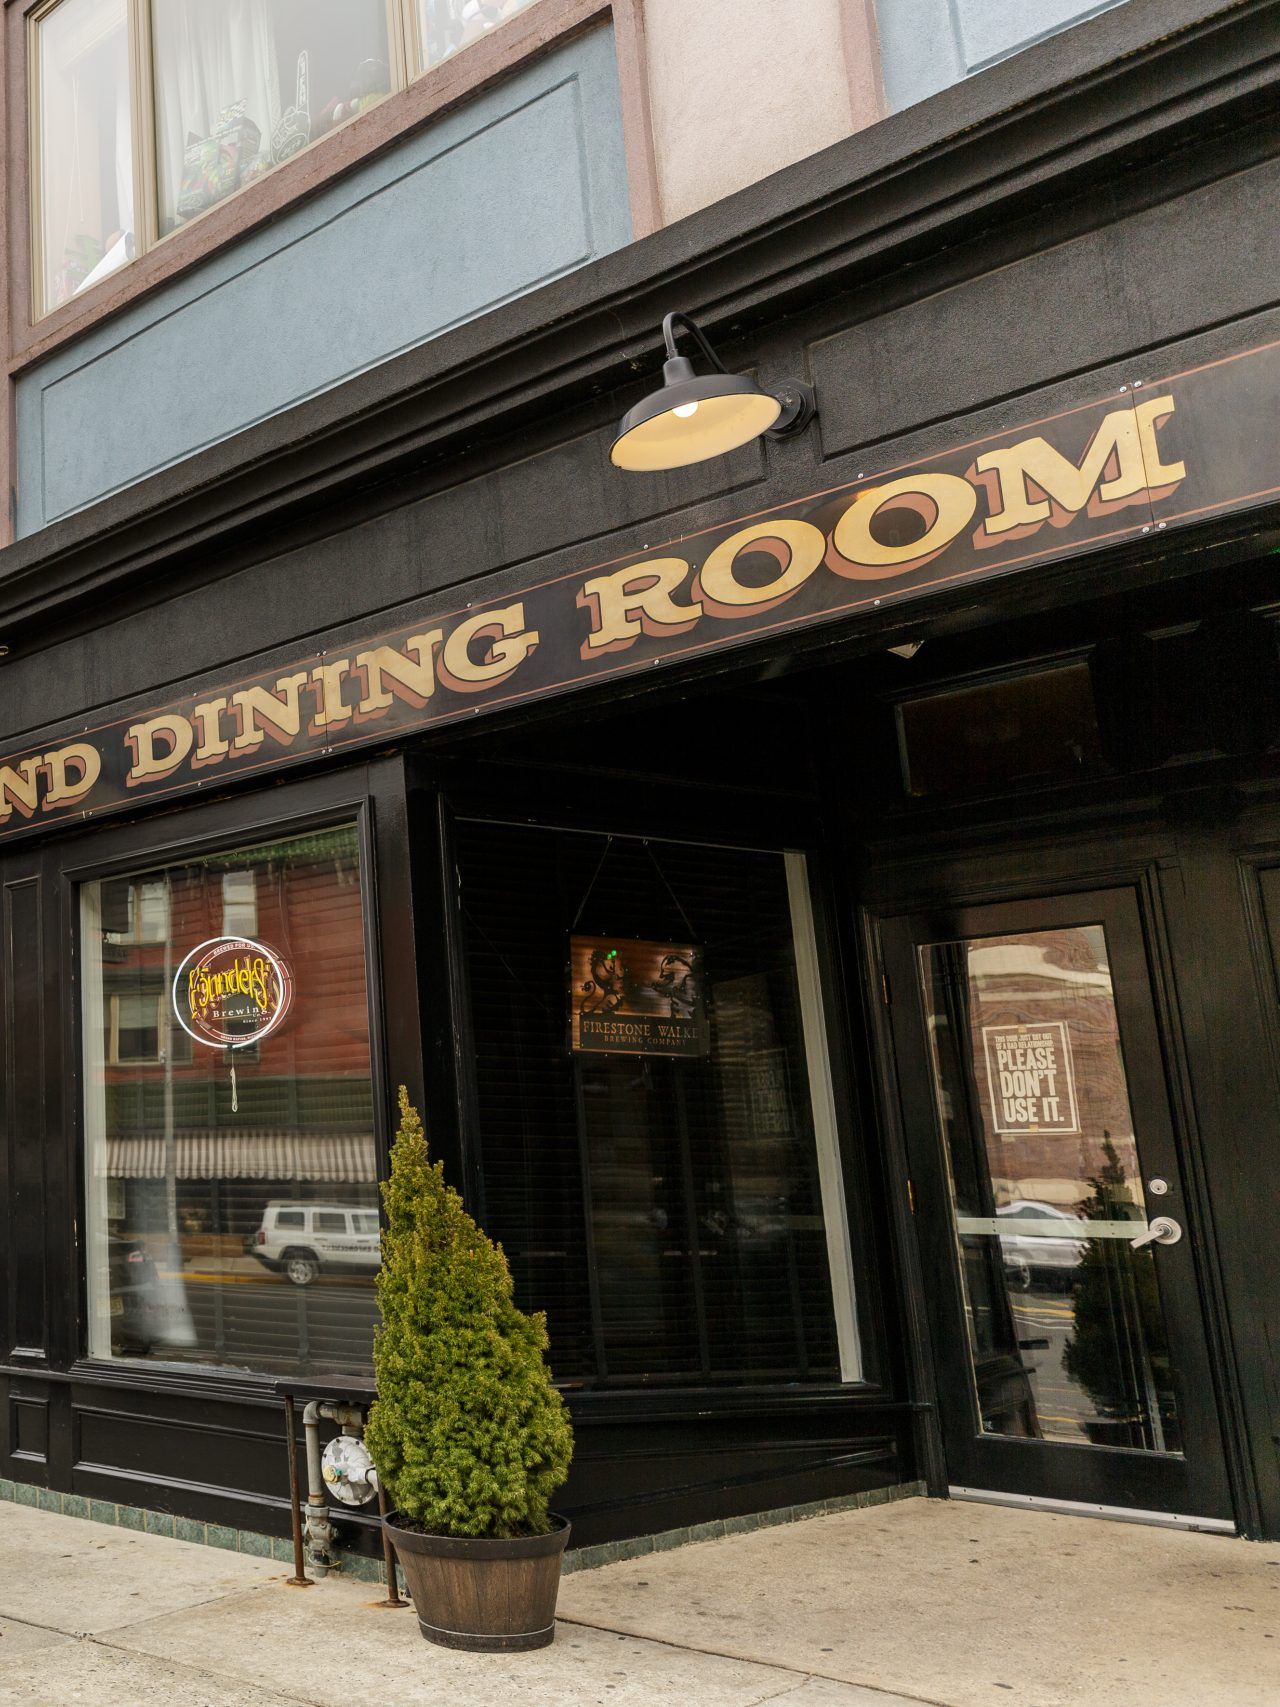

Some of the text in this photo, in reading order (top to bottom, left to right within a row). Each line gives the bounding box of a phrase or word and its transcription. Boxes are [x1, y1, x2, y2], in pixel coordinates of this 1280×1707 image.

[124, 602, 540, 788] DINING
[577, 394, 1187, 660] ROOM
[213, 1006, 268, 1018] Brewing
[583, 1020, 700, 1039] FIRESTONE WALKE
[1018, 1034, 1031, 1042] JUST
[604, 1035, 643, 1044] BREWING
[995, 1042, 1003, 1050] OF
[997, 1047, 1057, 1071] PLEASE
[1000, 1069, 1057, 1098] DON'T
[1002, 1096, 1065, 1123] USE IT.
